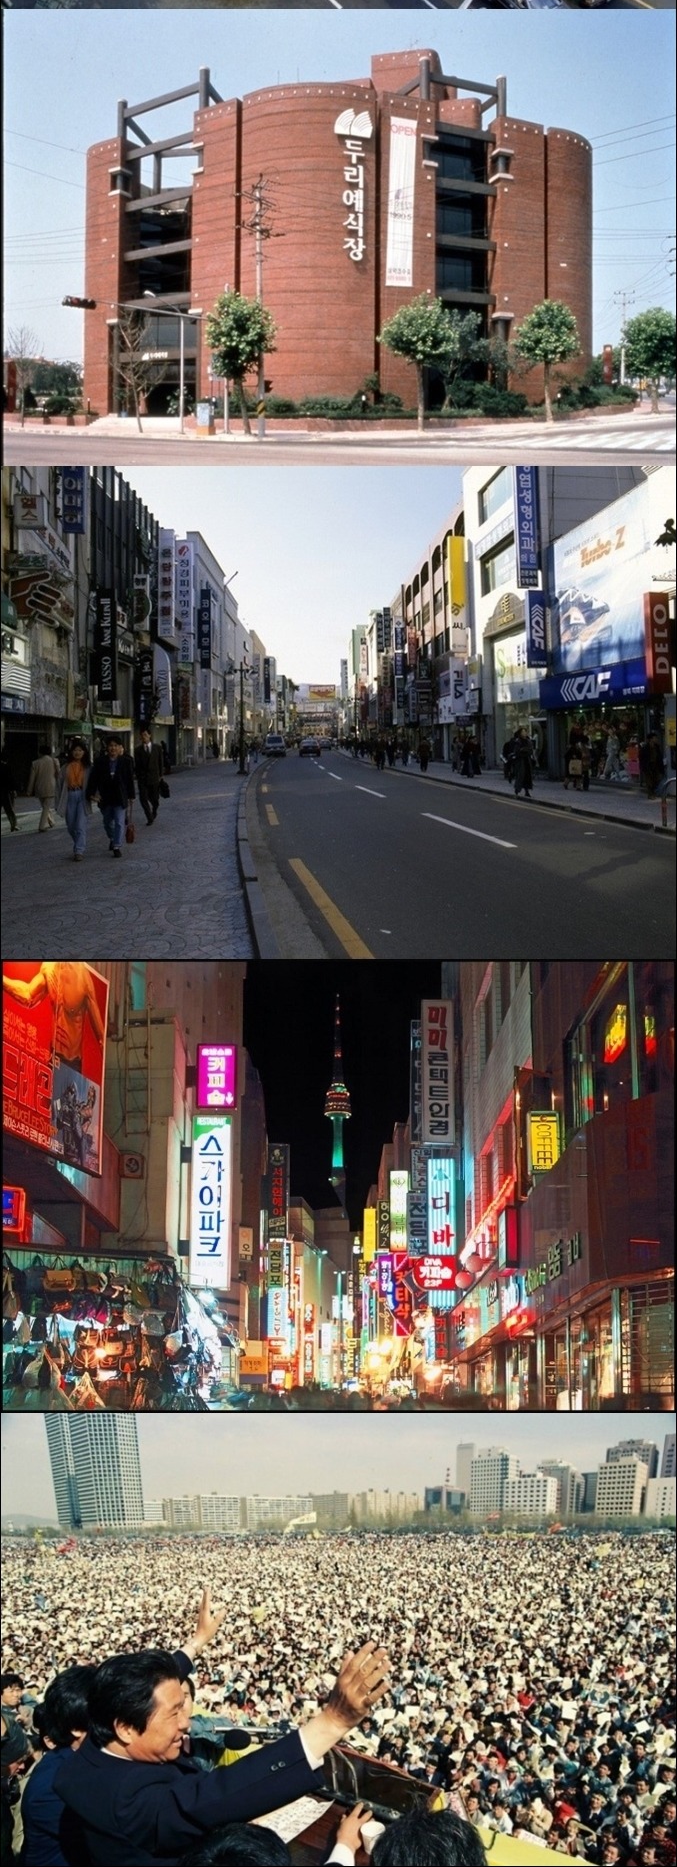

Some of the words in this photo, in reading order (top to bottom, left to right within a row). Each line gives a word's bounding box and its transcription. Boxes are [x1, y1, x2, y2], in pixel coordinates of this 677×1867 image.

[390, 124, 416, 136] OPEN
[342, 139, 367, 262] 두리예식장
[102, 656, 111, 691] BASSO
[453, 670, 465, 701] FILA
[196, 1117, 228, 1126] RESTAURANT
[536, 1123, 553, 1164] COFFEE
[198, 1135, 226, 1257] 스카이파크
[431, 1191, 455, 1248] 디바
[423, 1258, 443, 1266] DIVA
